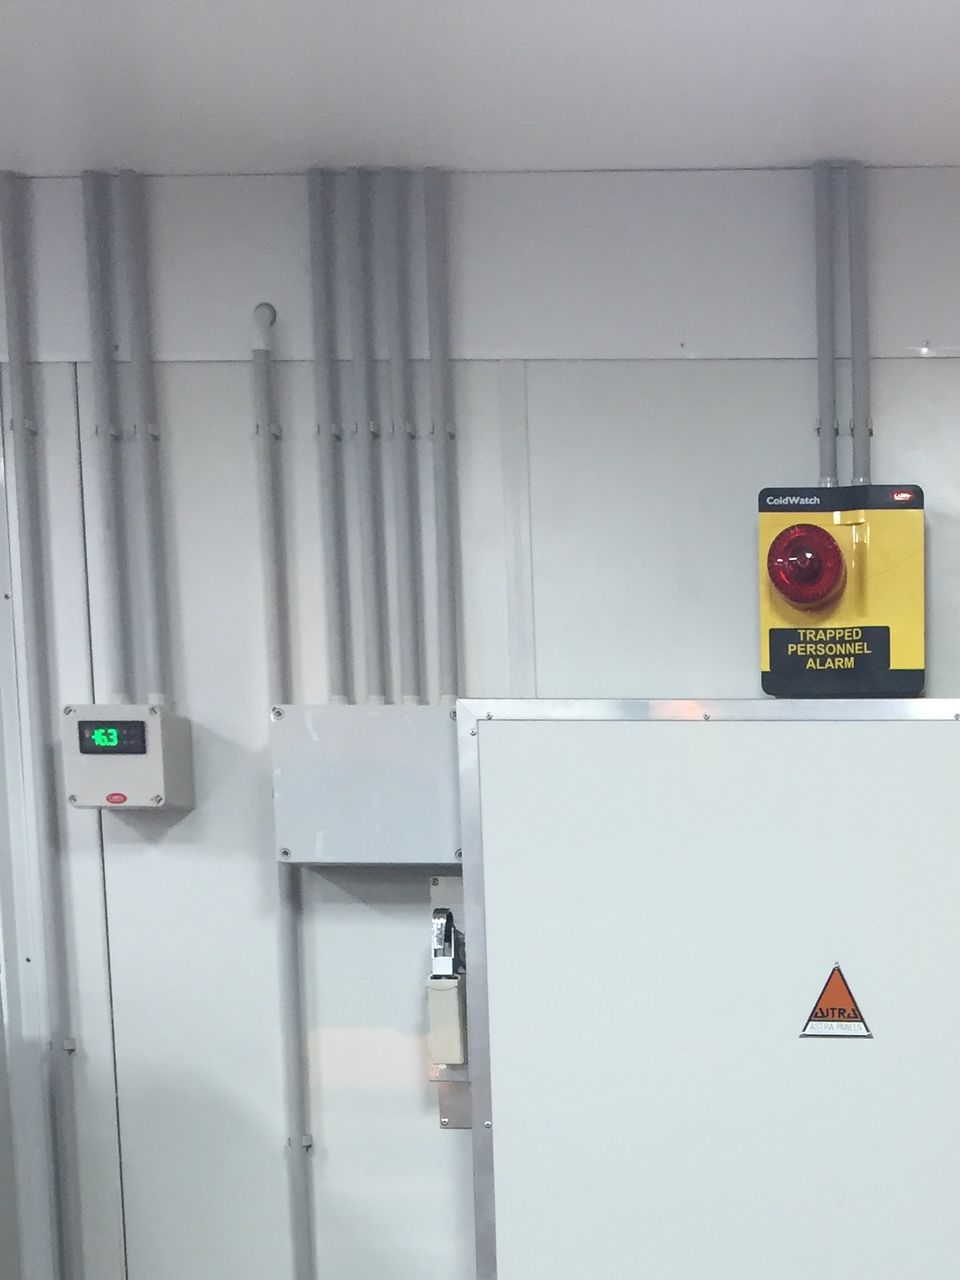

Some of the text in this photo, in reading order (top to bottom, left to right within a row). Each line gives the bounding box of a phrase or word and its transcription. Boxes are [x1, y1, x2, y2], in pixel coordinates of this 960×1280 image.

[766, 496, 821, 505] ColdWatch
[797, 628, 862, 641] TRAPPED
[787, 642, 872, 656] PERSONNEL
[805, 657, 855, 669] ALARM
